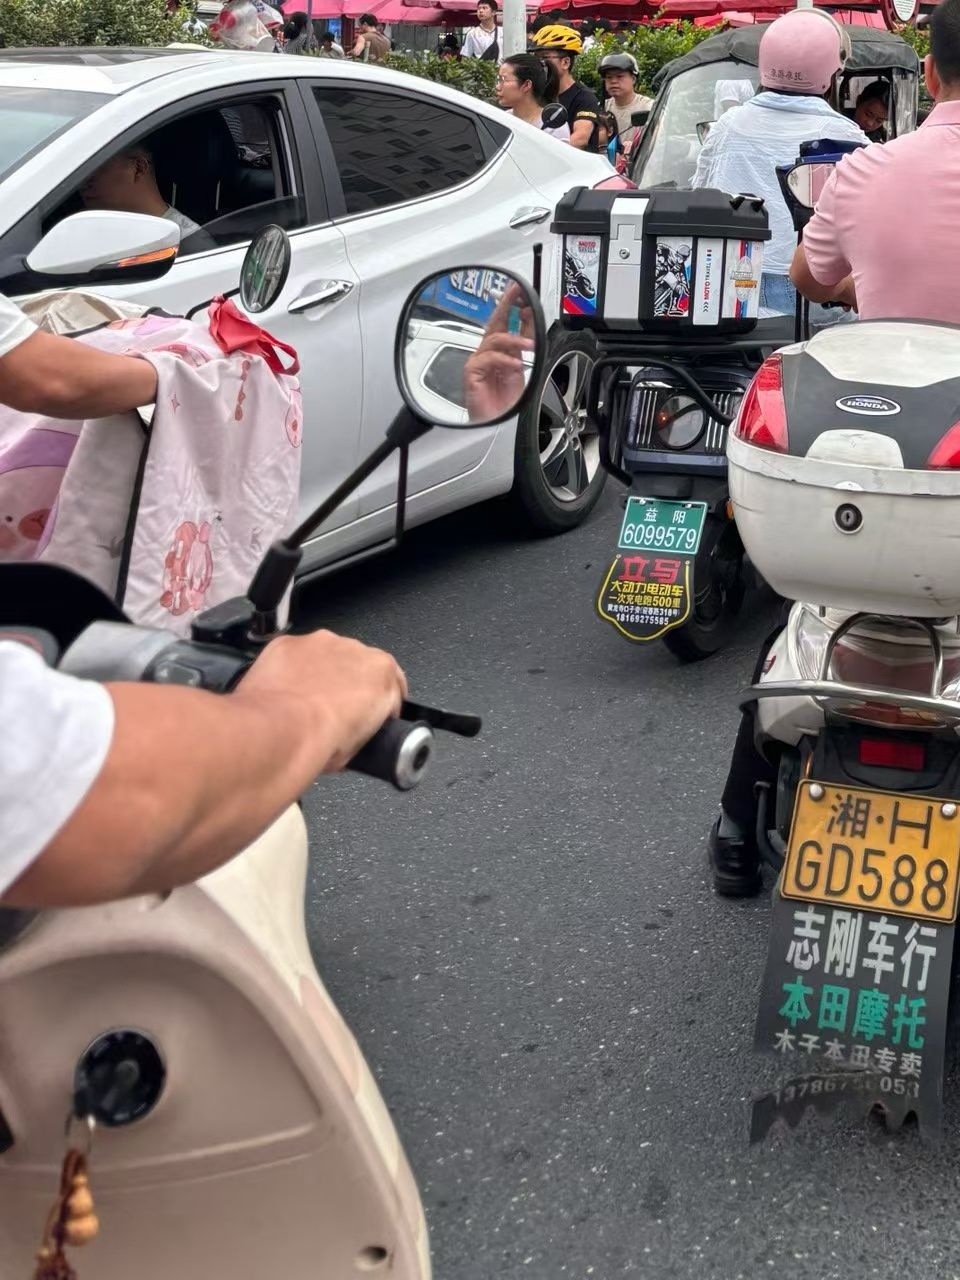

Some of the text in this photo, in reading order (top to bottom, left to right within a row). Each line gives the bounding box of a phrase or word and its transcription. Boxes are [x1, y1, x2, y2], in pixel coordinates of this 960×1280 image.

[847, 400, 888, 410] HONDA
[644, 508, 686, 524] 益阳
[623, 523, 697, 550] 6099579
[618, 555, 681, 584] 立马
[608, 594, 681, 608] 一次充电跑500里
[610, 580, 683, 597] 大动力电动车
[794, 840, 949, 912] GD588
[785, 906, 937, 992] 志刚车行
[778, 975, 927, 1049] 本田摩托
[774, 1029, 922, 1077] 木子本田专卖
